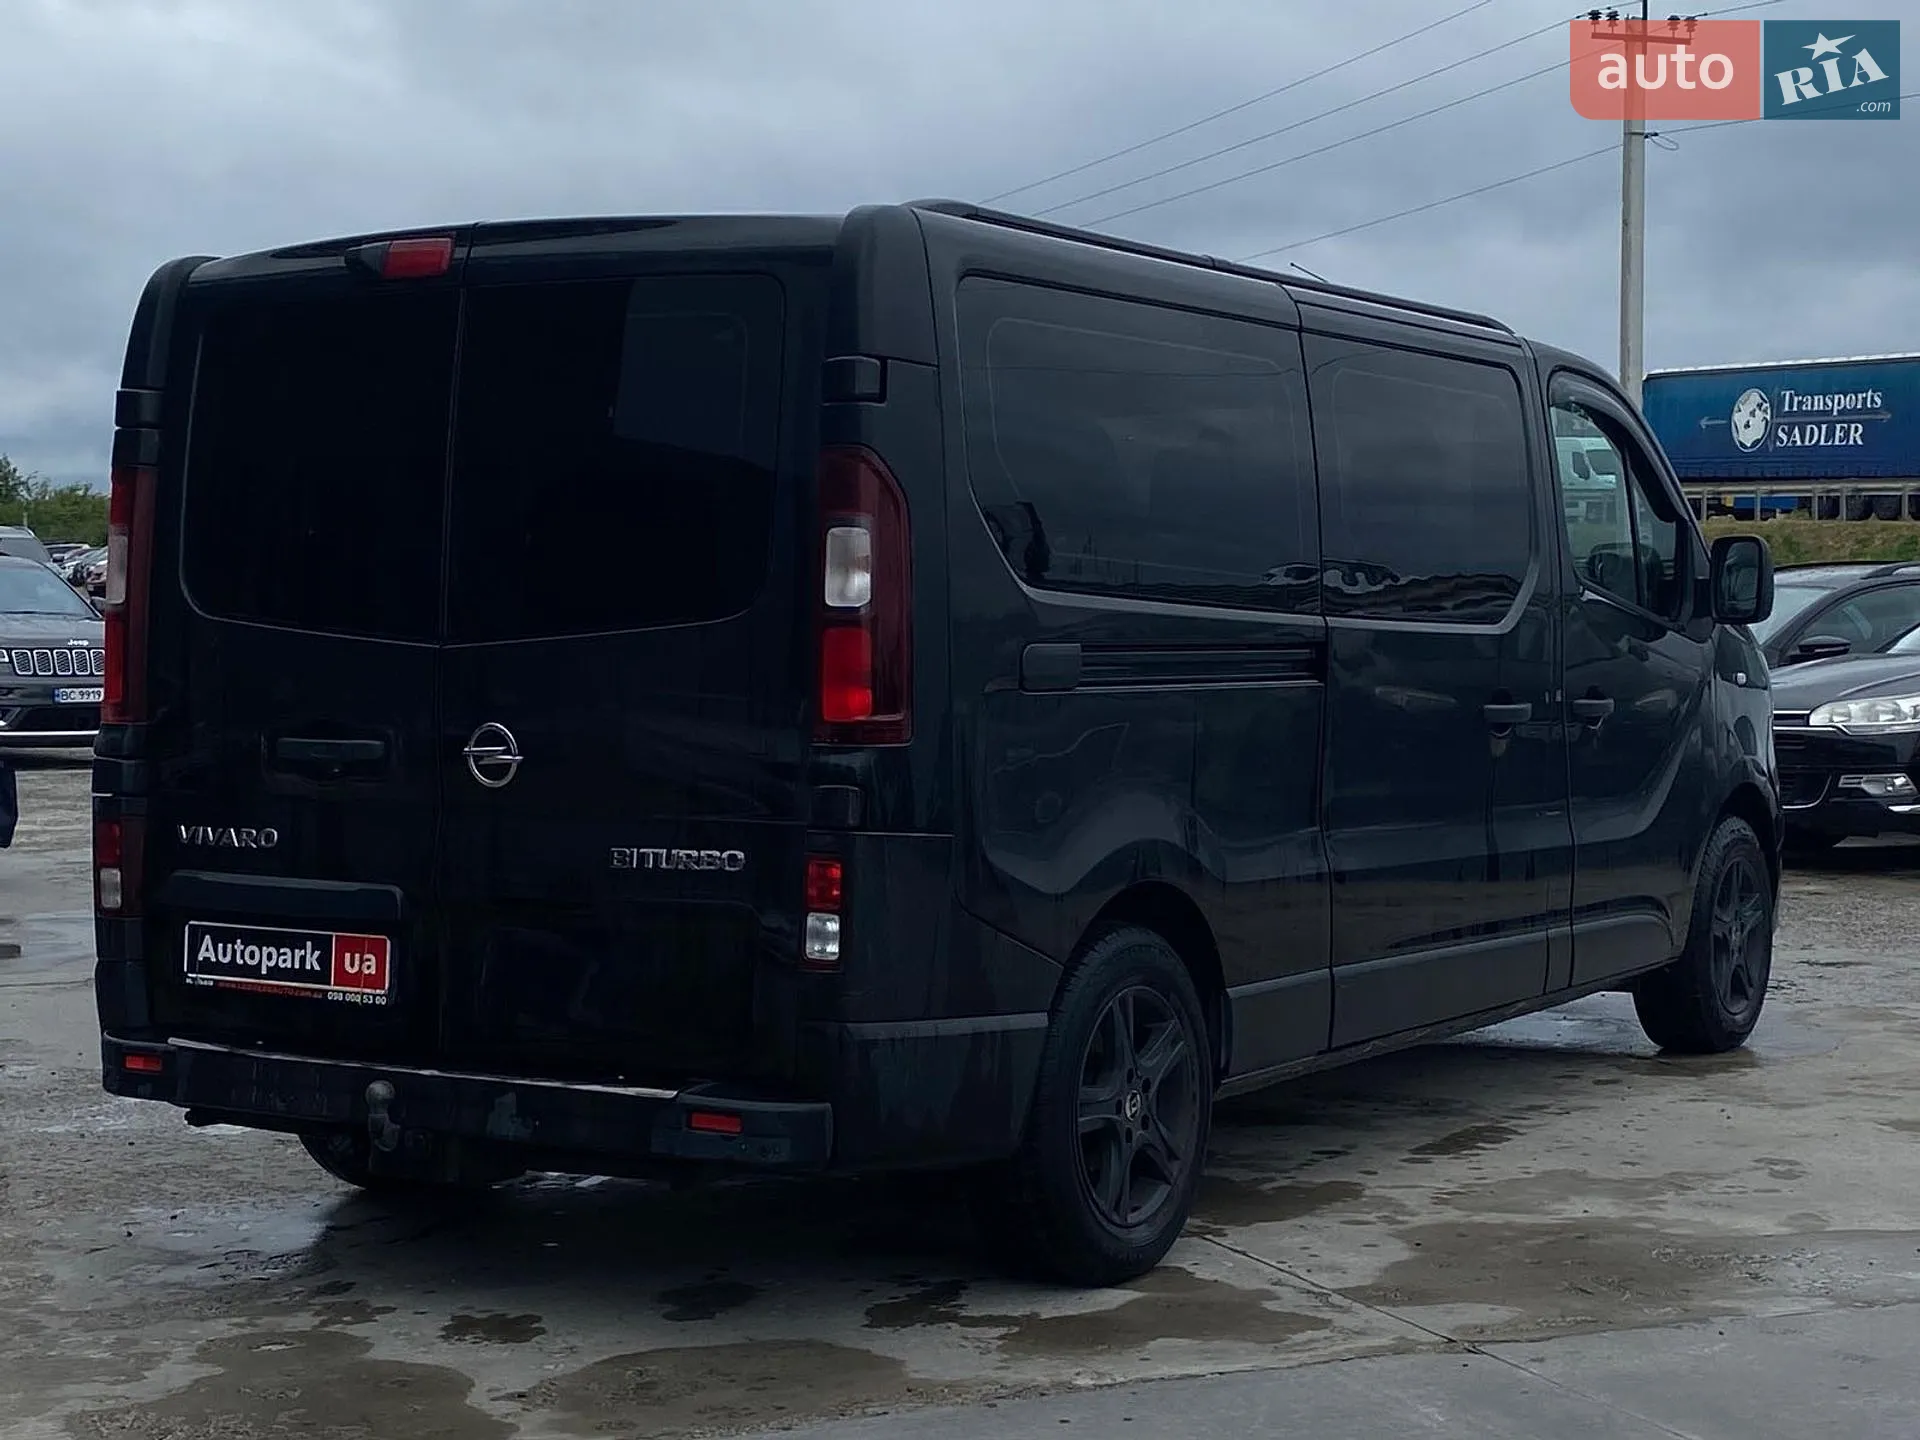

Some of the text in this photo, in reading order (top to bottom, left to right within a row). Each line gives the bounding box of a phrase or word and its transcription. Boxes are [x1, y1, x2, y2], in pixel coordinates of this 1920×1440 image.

[1780, 387, 1882, 416] Transports
[1775, 423, 1864, 447] SADLER
[79, 690, 102, 700] 9919
[177, 824, 279, 848] VIVARO
[610, 847, 746, 872] BITURBO
[197, 934, 377, 975] Autopark ua
